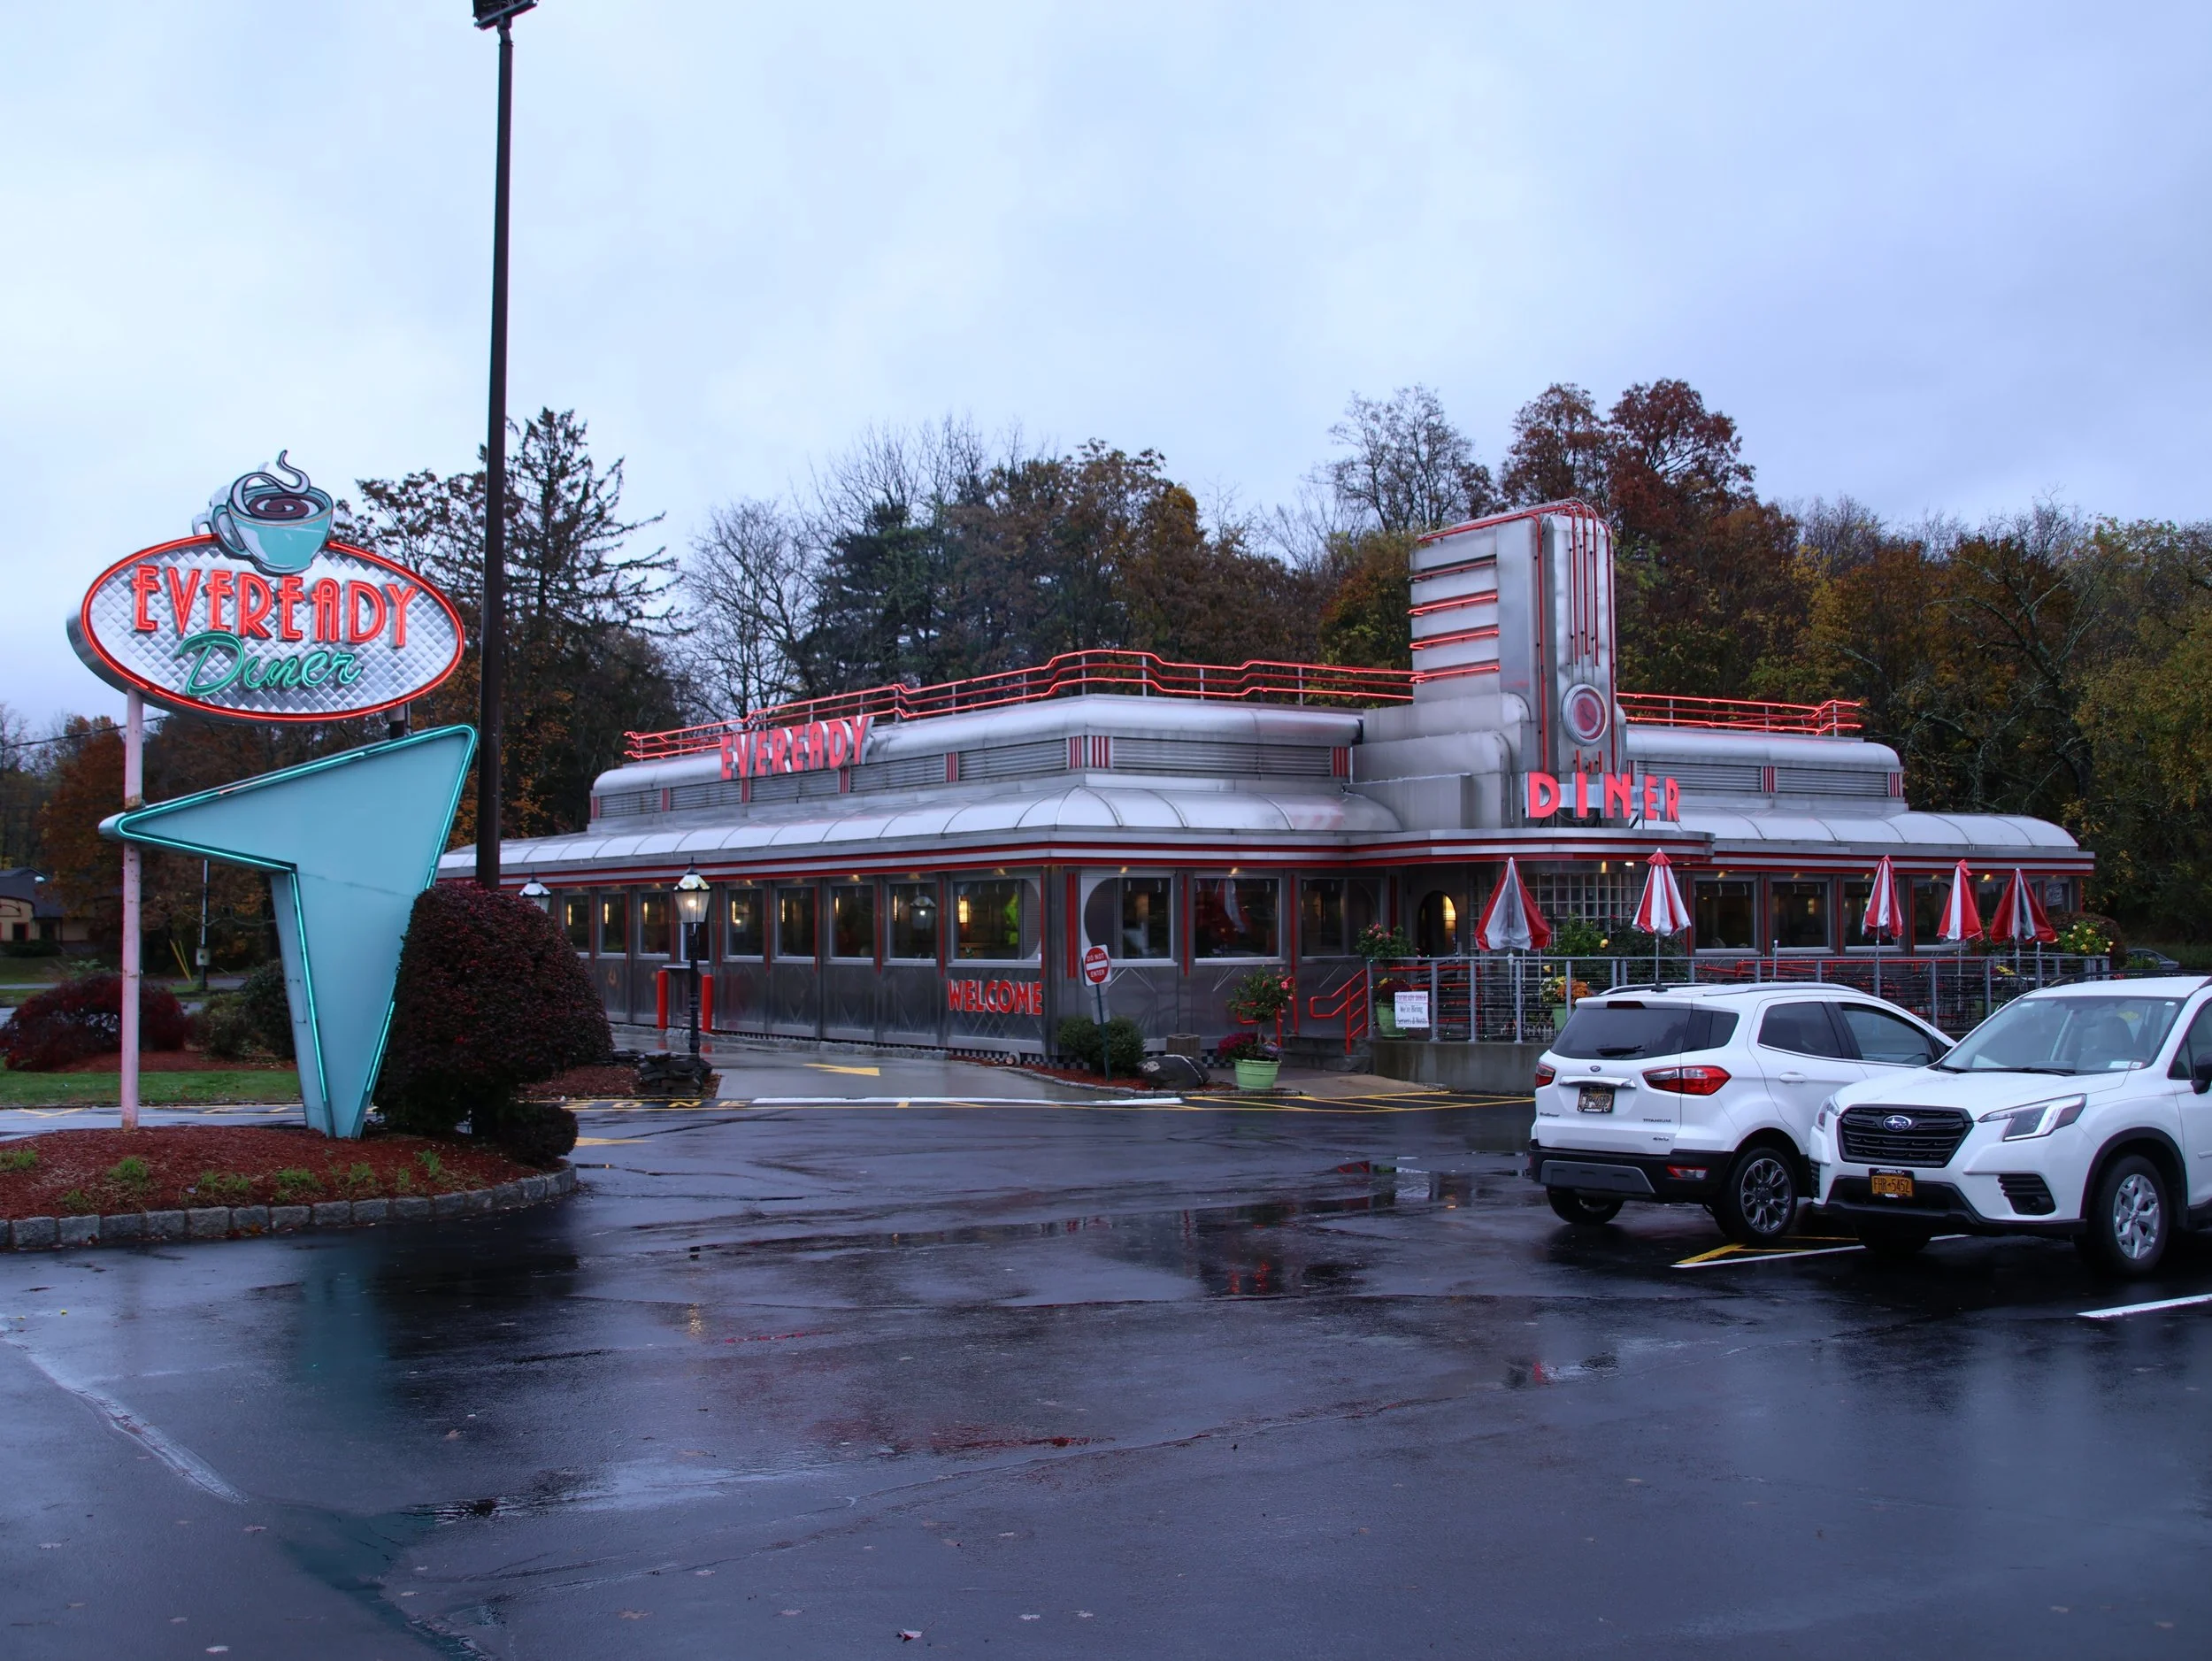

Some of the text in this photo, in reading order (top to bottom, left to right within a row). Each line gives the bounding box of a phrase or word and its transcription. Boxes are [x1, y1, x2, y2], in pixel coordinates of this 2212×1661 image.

[132, 565, 418, 649] EVEREADY
[178, 632, 363, 696] Diner
[720, 716, 872, 780] EVEREADY
[1525, 771, 1680, 822] DINER
[947, 979, 1043, 1016] WELCOME
[1090, 969, 1105, 978] ENTER
